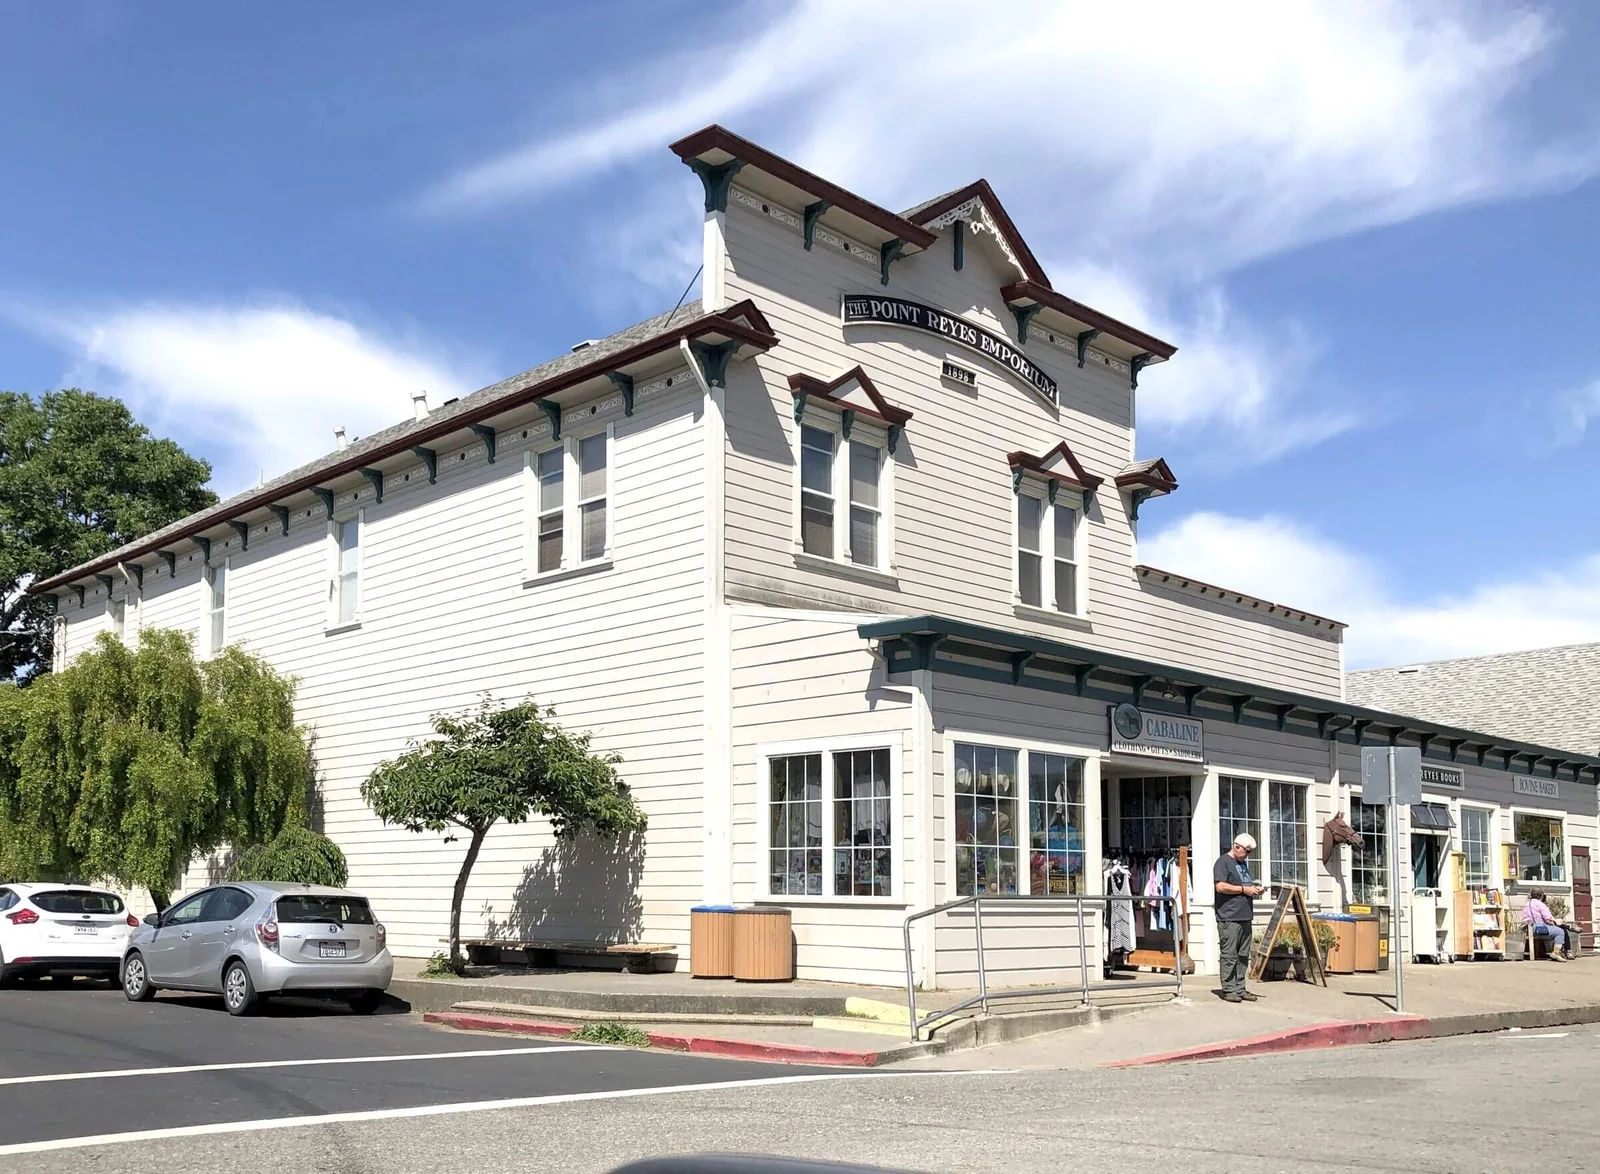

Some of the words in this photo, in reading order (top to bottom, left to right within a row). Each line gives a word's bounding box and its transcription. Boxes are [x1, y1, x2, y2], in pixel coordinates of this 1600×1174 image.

[846, 301, 870, 316] THE
[869, 299, 921, 323] POINT
[927, 310, 977, 345] REYES
[980, 333, 1056, 399] EMPORIUM
[947, 366, 970, 382] 1898
[1146, 718, 1199, 742] CABALINE
[1114, 740, 1146, 752] CLOTHING
[1151, 744, 1169, 755] GIFTS
[1421, 770, 1439, 781] REYES
[1441, 772, 1459, 784] BOOKS
[1519, 778, 1538, 793] BOVINE
